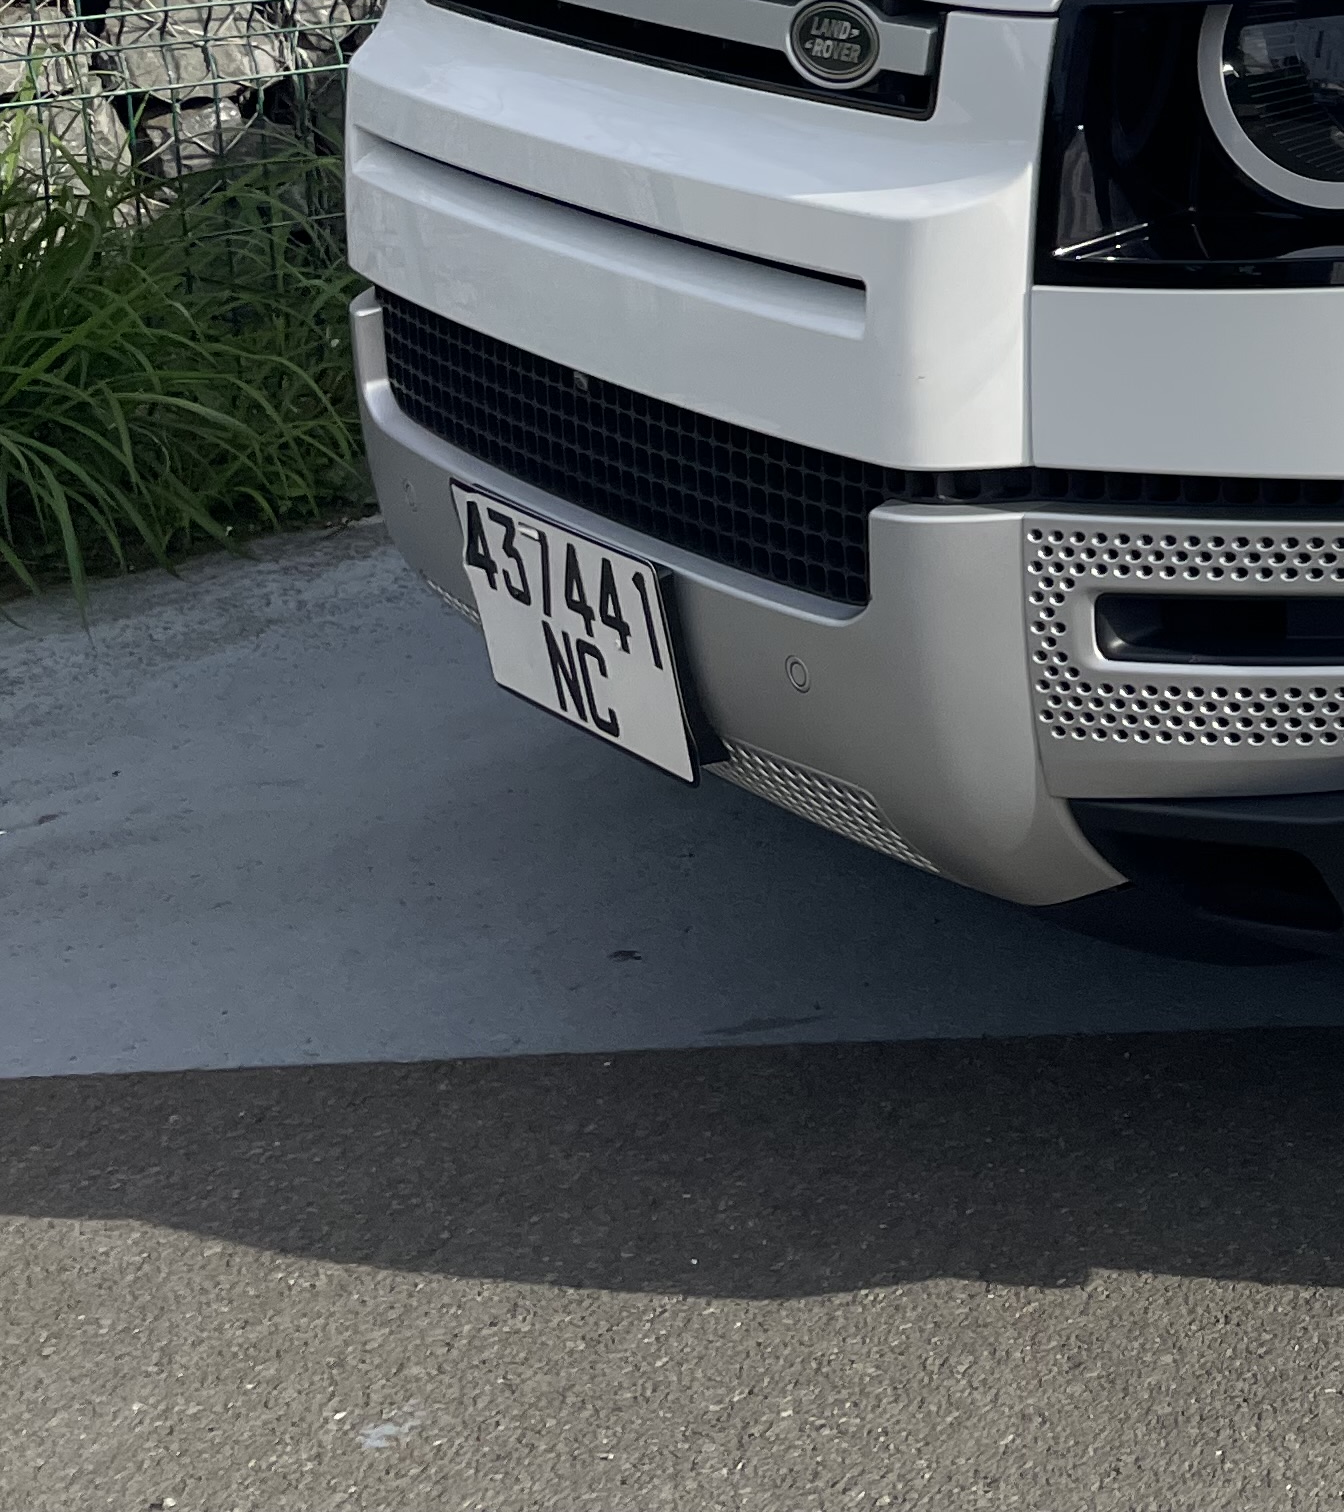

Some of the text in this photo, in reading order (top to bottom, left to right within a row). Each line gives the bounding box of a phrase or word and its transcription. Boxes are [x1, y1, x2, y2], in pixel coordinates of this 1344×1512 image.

[810, 16, 853, 40] LAND
[811, 38, 862, 64] ROVER
[466, 500, 664, 671] 437441
[541, 620, 620, 739] NC
